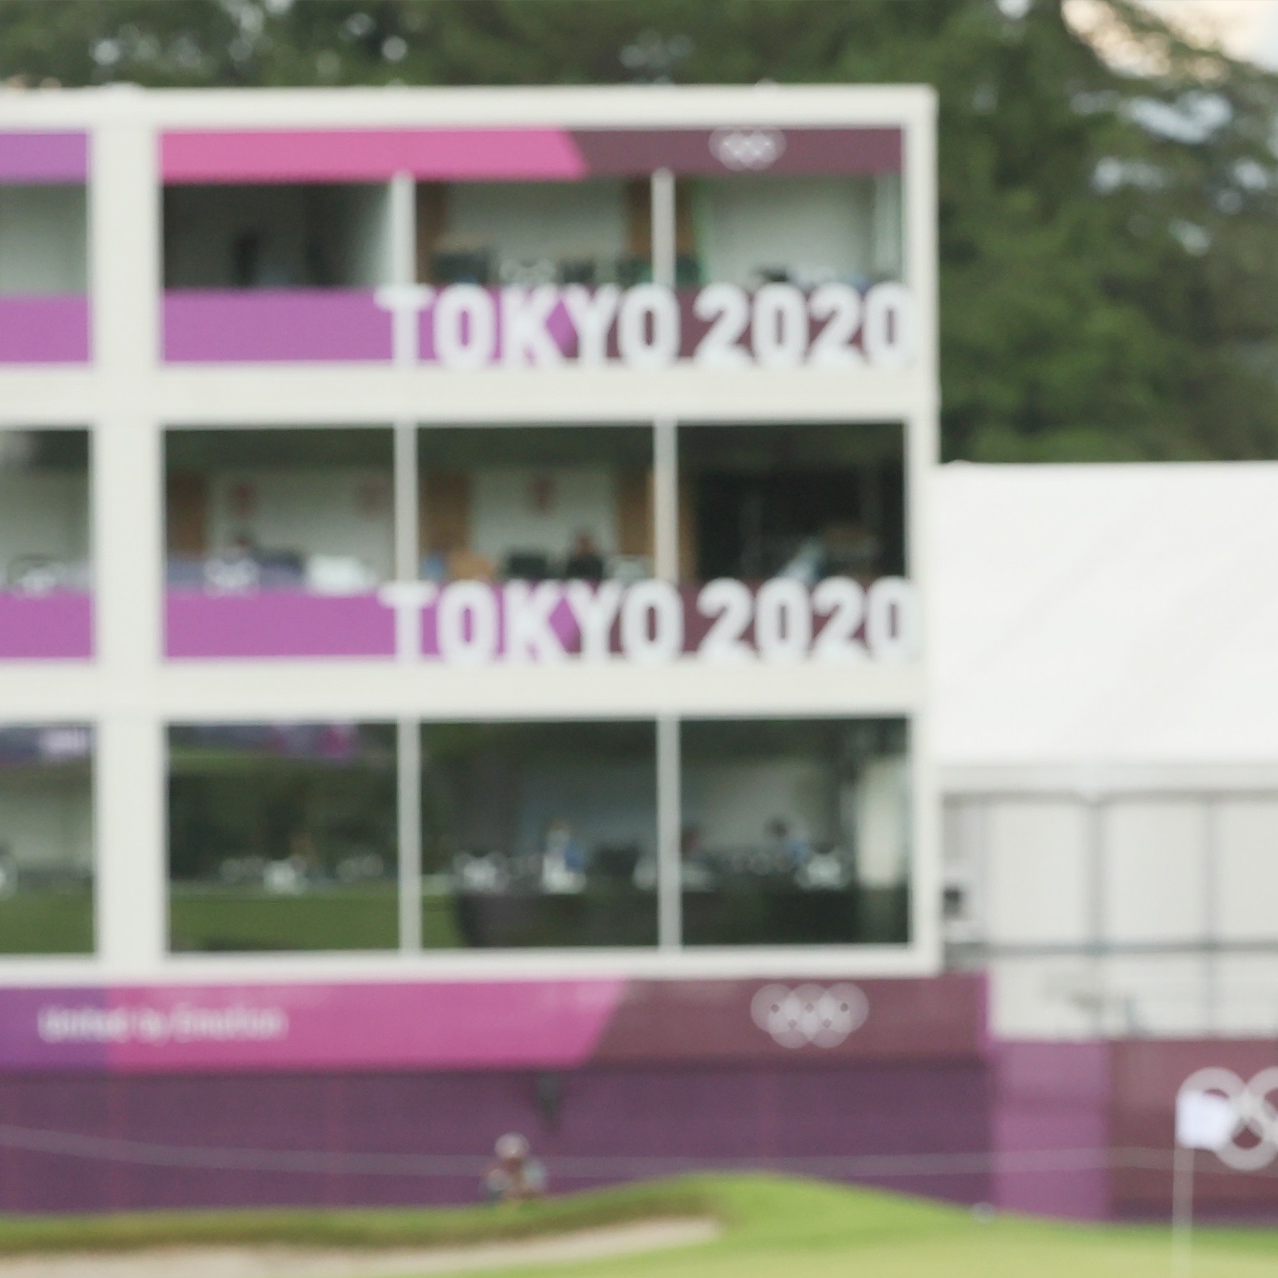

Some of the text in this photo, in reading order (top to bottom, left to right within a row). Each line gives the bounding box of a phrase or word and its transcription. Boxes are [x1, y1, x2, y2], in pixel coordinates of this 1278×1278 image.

[375, 281, 919, 370] TOKYO 2020
[378, 576, 922, 666] TOKYO 2020
